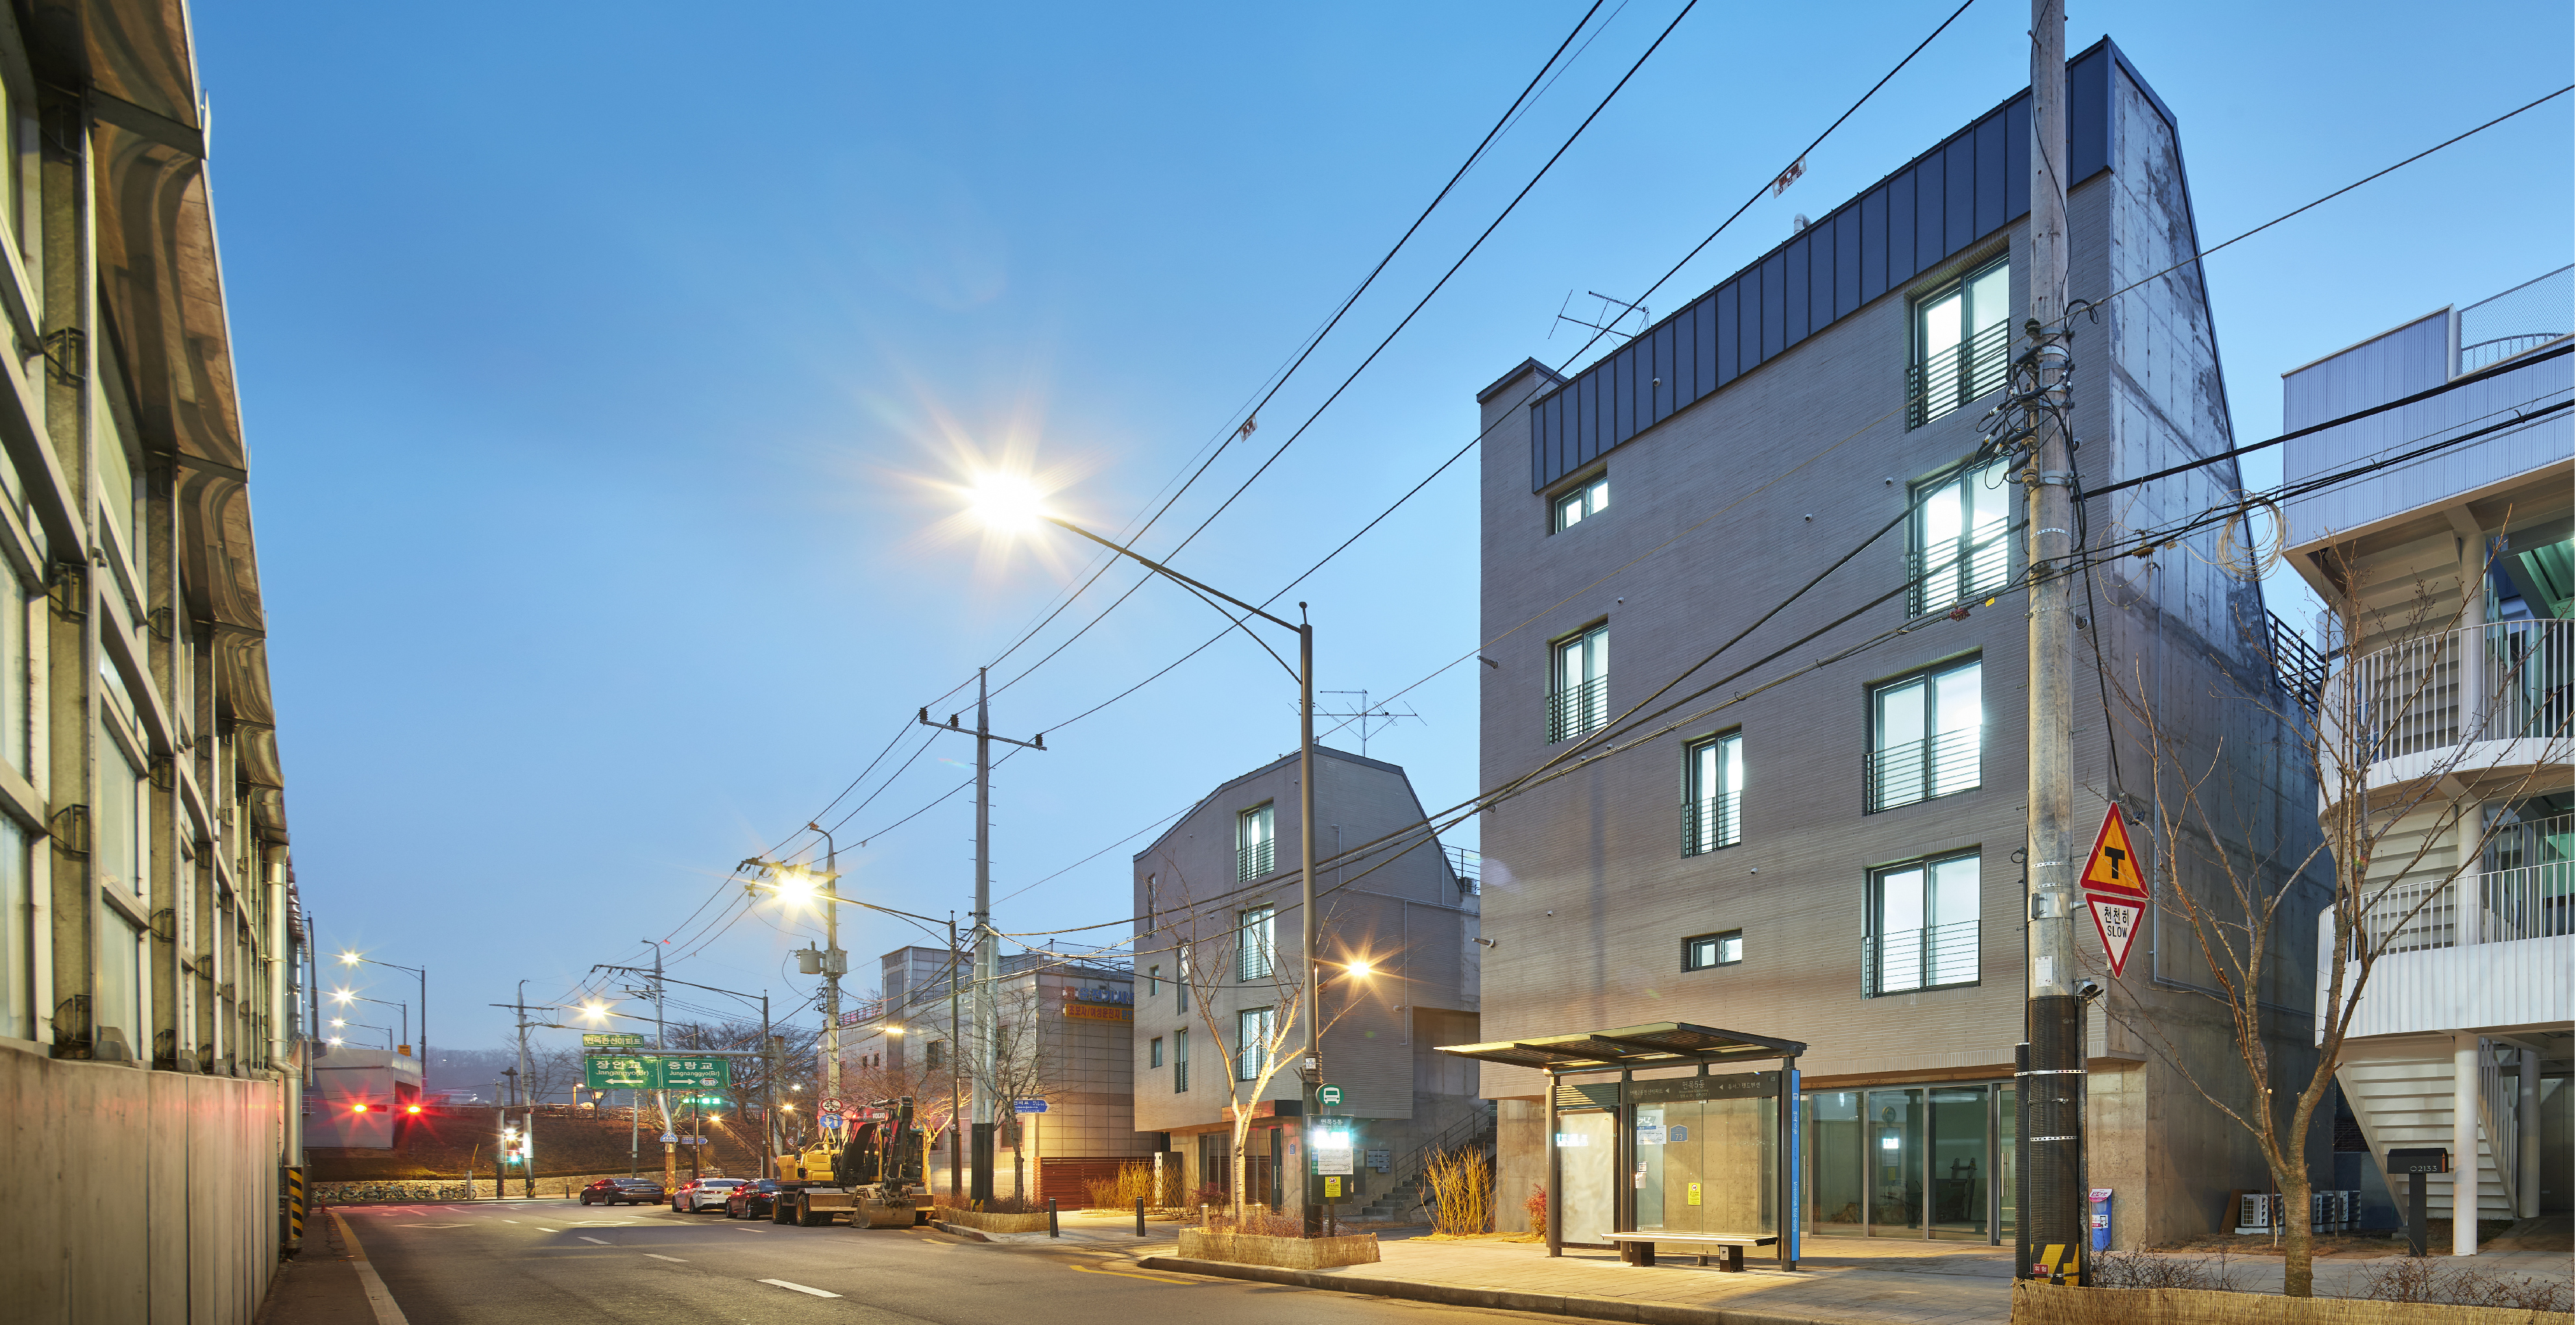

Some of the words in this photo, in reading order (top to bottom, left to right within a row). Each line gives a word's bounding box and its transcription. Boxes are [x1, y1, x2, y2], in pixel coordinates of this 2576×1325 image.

[2104, 906, 2129, 926] 천천히
[2107, 925, 2128, 938] SLOW
[585, 1037, 641, 1045] 면목한신아파트
[596, 1060, 642, 1069] 장안교
[668, 1061, 713, 1070] 중랑교
[1682, 1080, 1705, 1090] 면목5동
